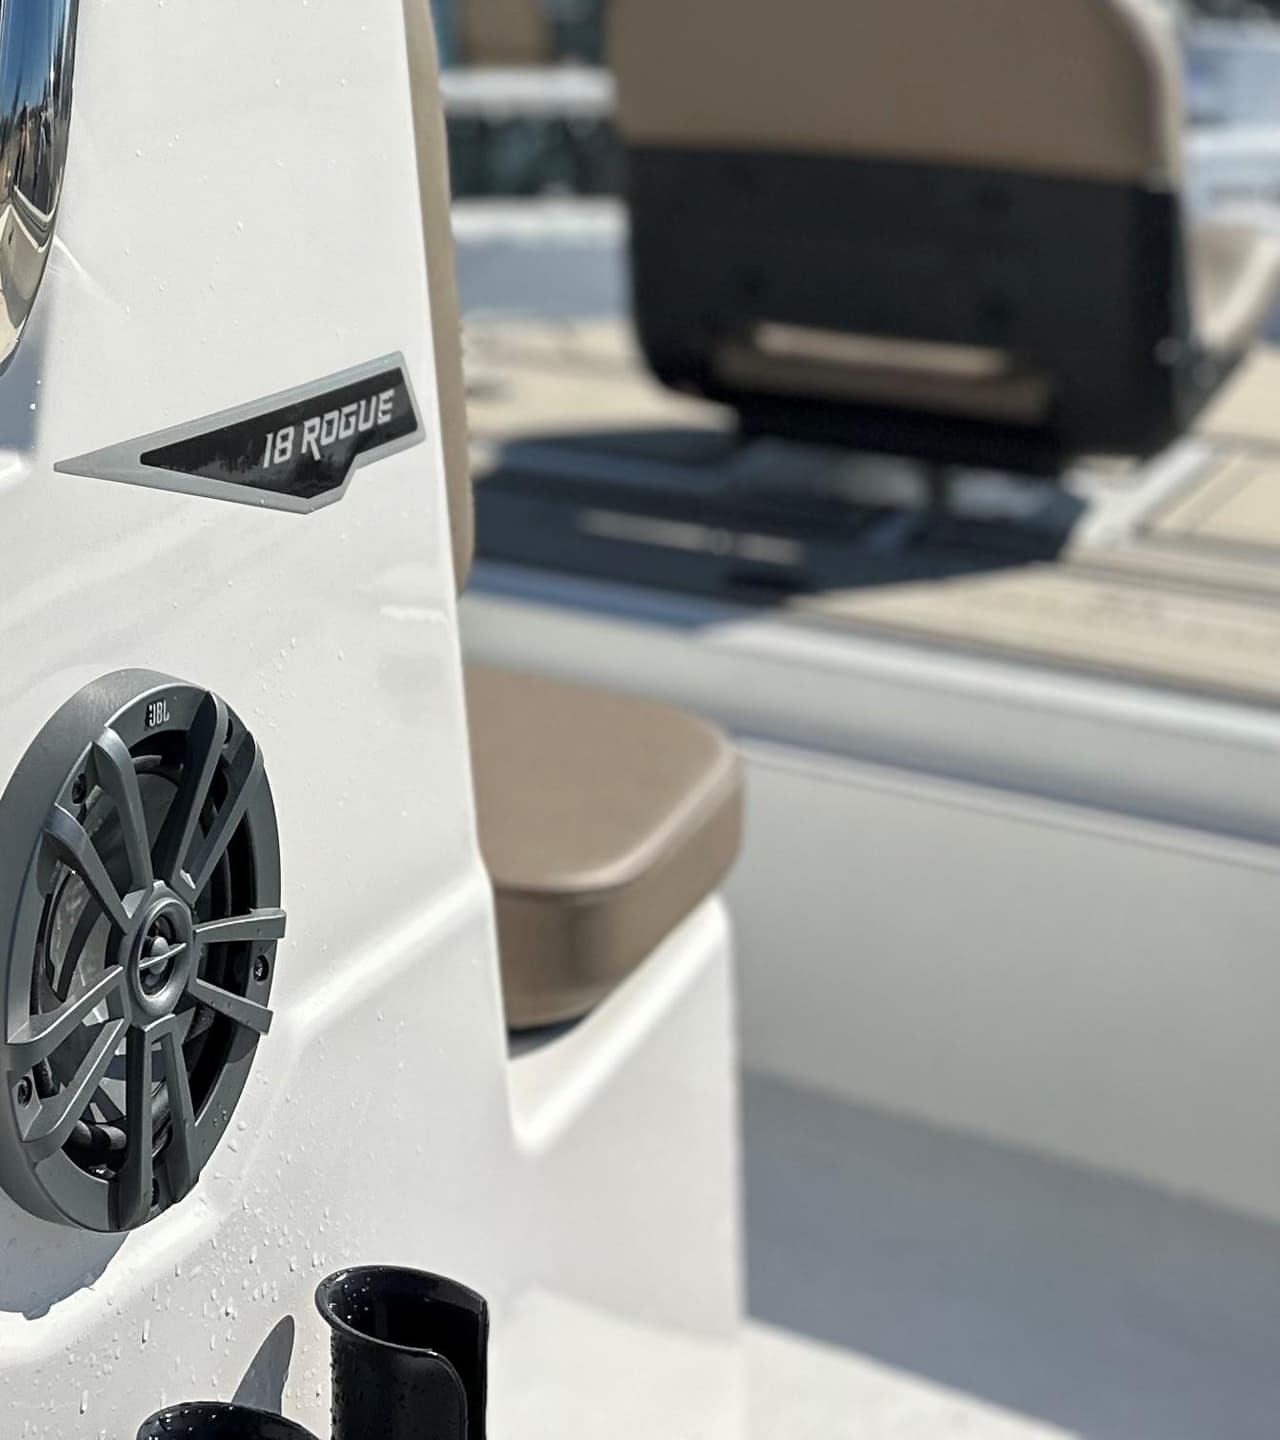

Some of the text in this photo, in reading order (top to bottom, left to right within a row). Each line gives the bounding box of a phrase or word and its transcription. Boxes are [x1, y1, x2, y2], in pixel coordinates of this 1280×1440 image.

[262, 389, 395, 469] 18 ROGUE
[149, 700, 170, 727] JBL
